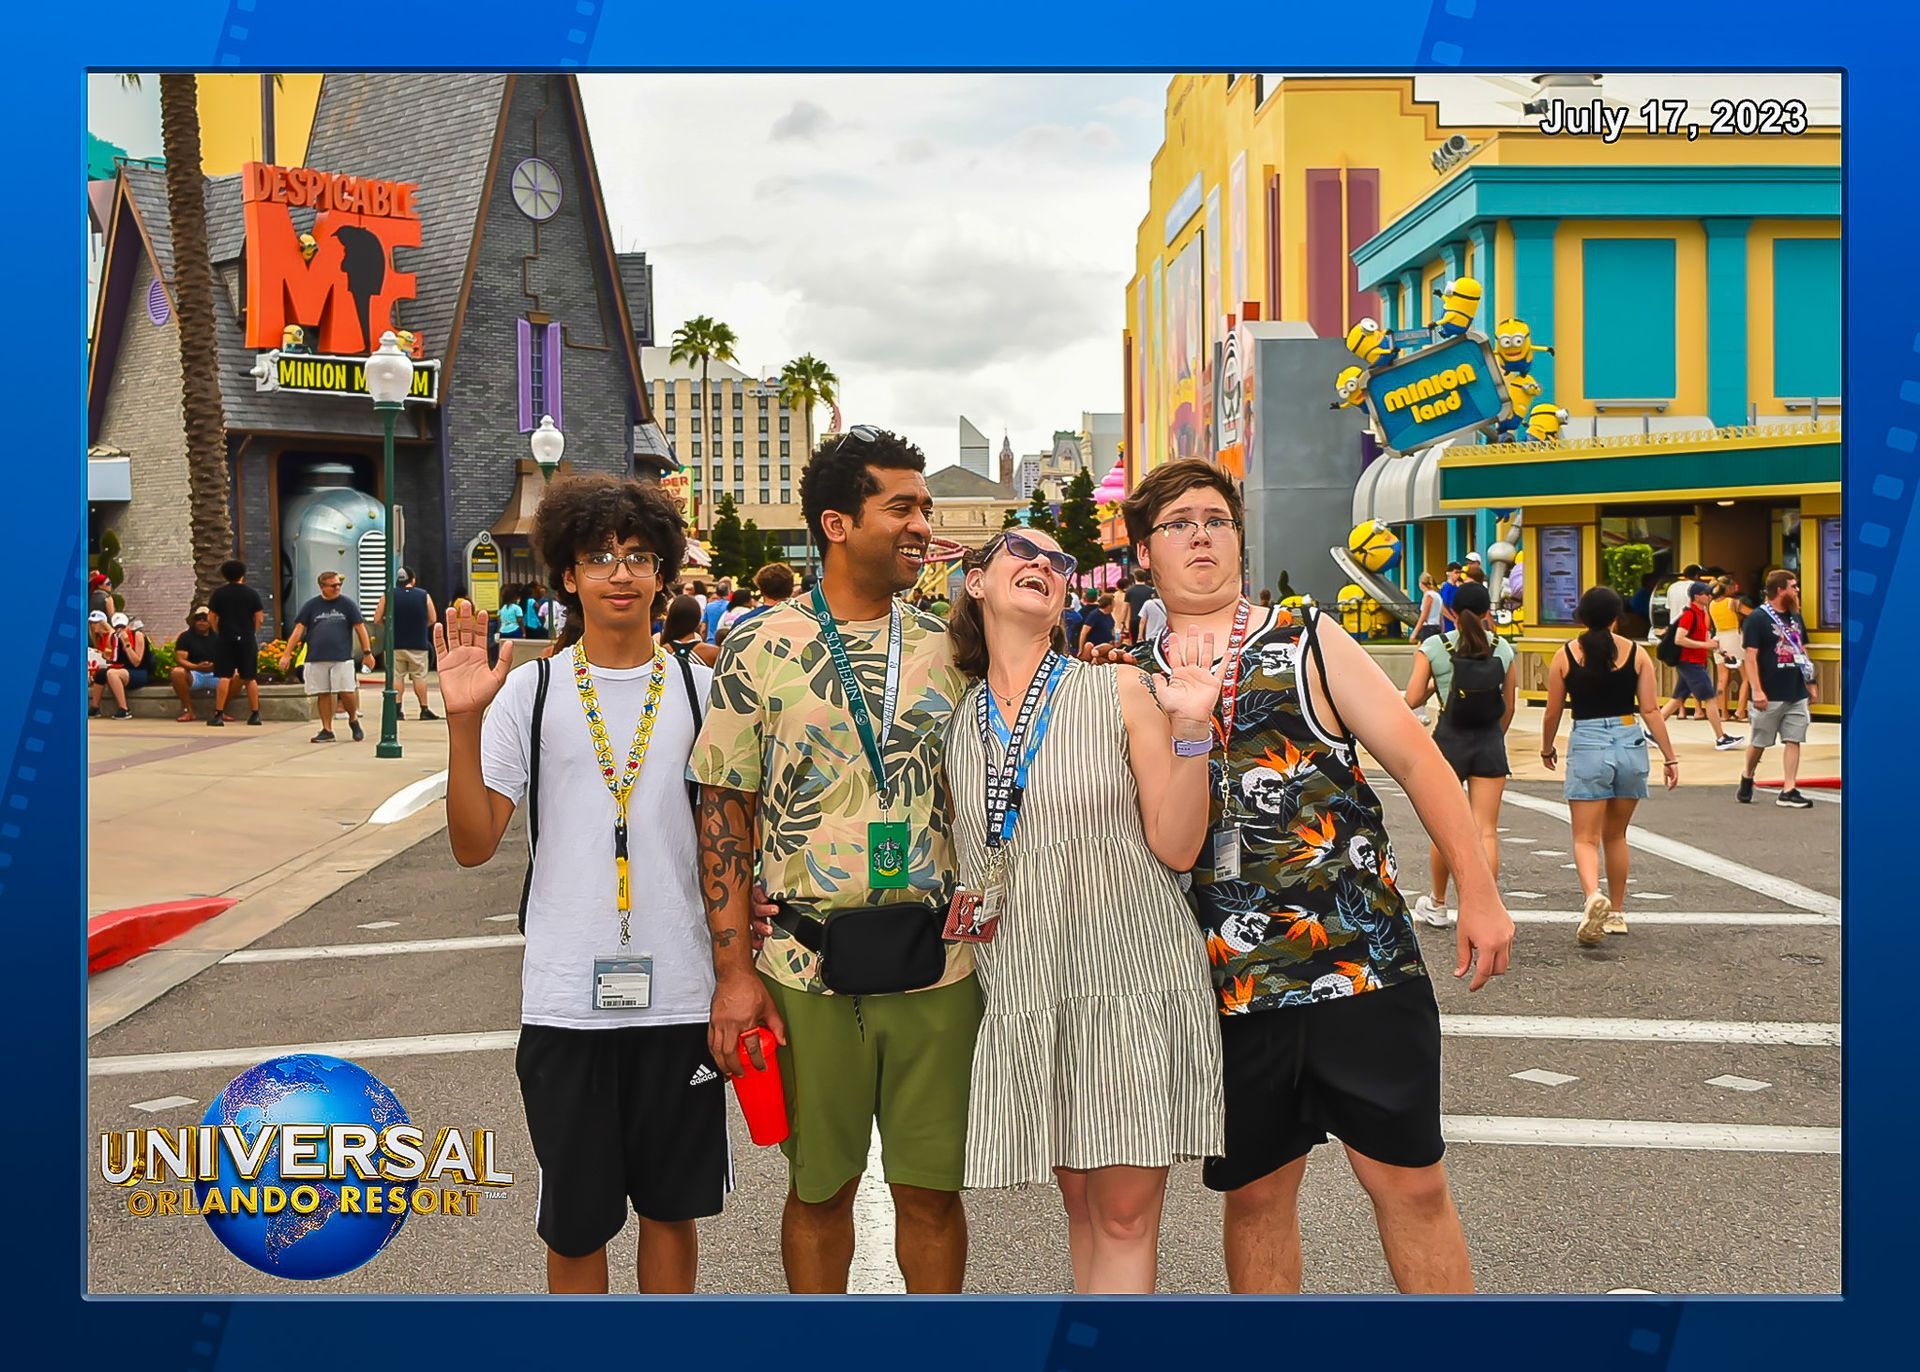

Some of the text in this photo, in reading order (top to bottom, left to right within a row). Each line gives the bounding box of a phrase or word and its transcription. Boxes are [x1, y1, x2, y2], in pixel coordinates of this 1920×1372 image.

[254, 165, 421, 218] DESPICABLE
[246, 201, 424, 358] ME
[279, 360, 347, 390] MINION
[825, 631, 861, 701] SLYTHERIN
[690, 1071, 718, 1086] adidas
